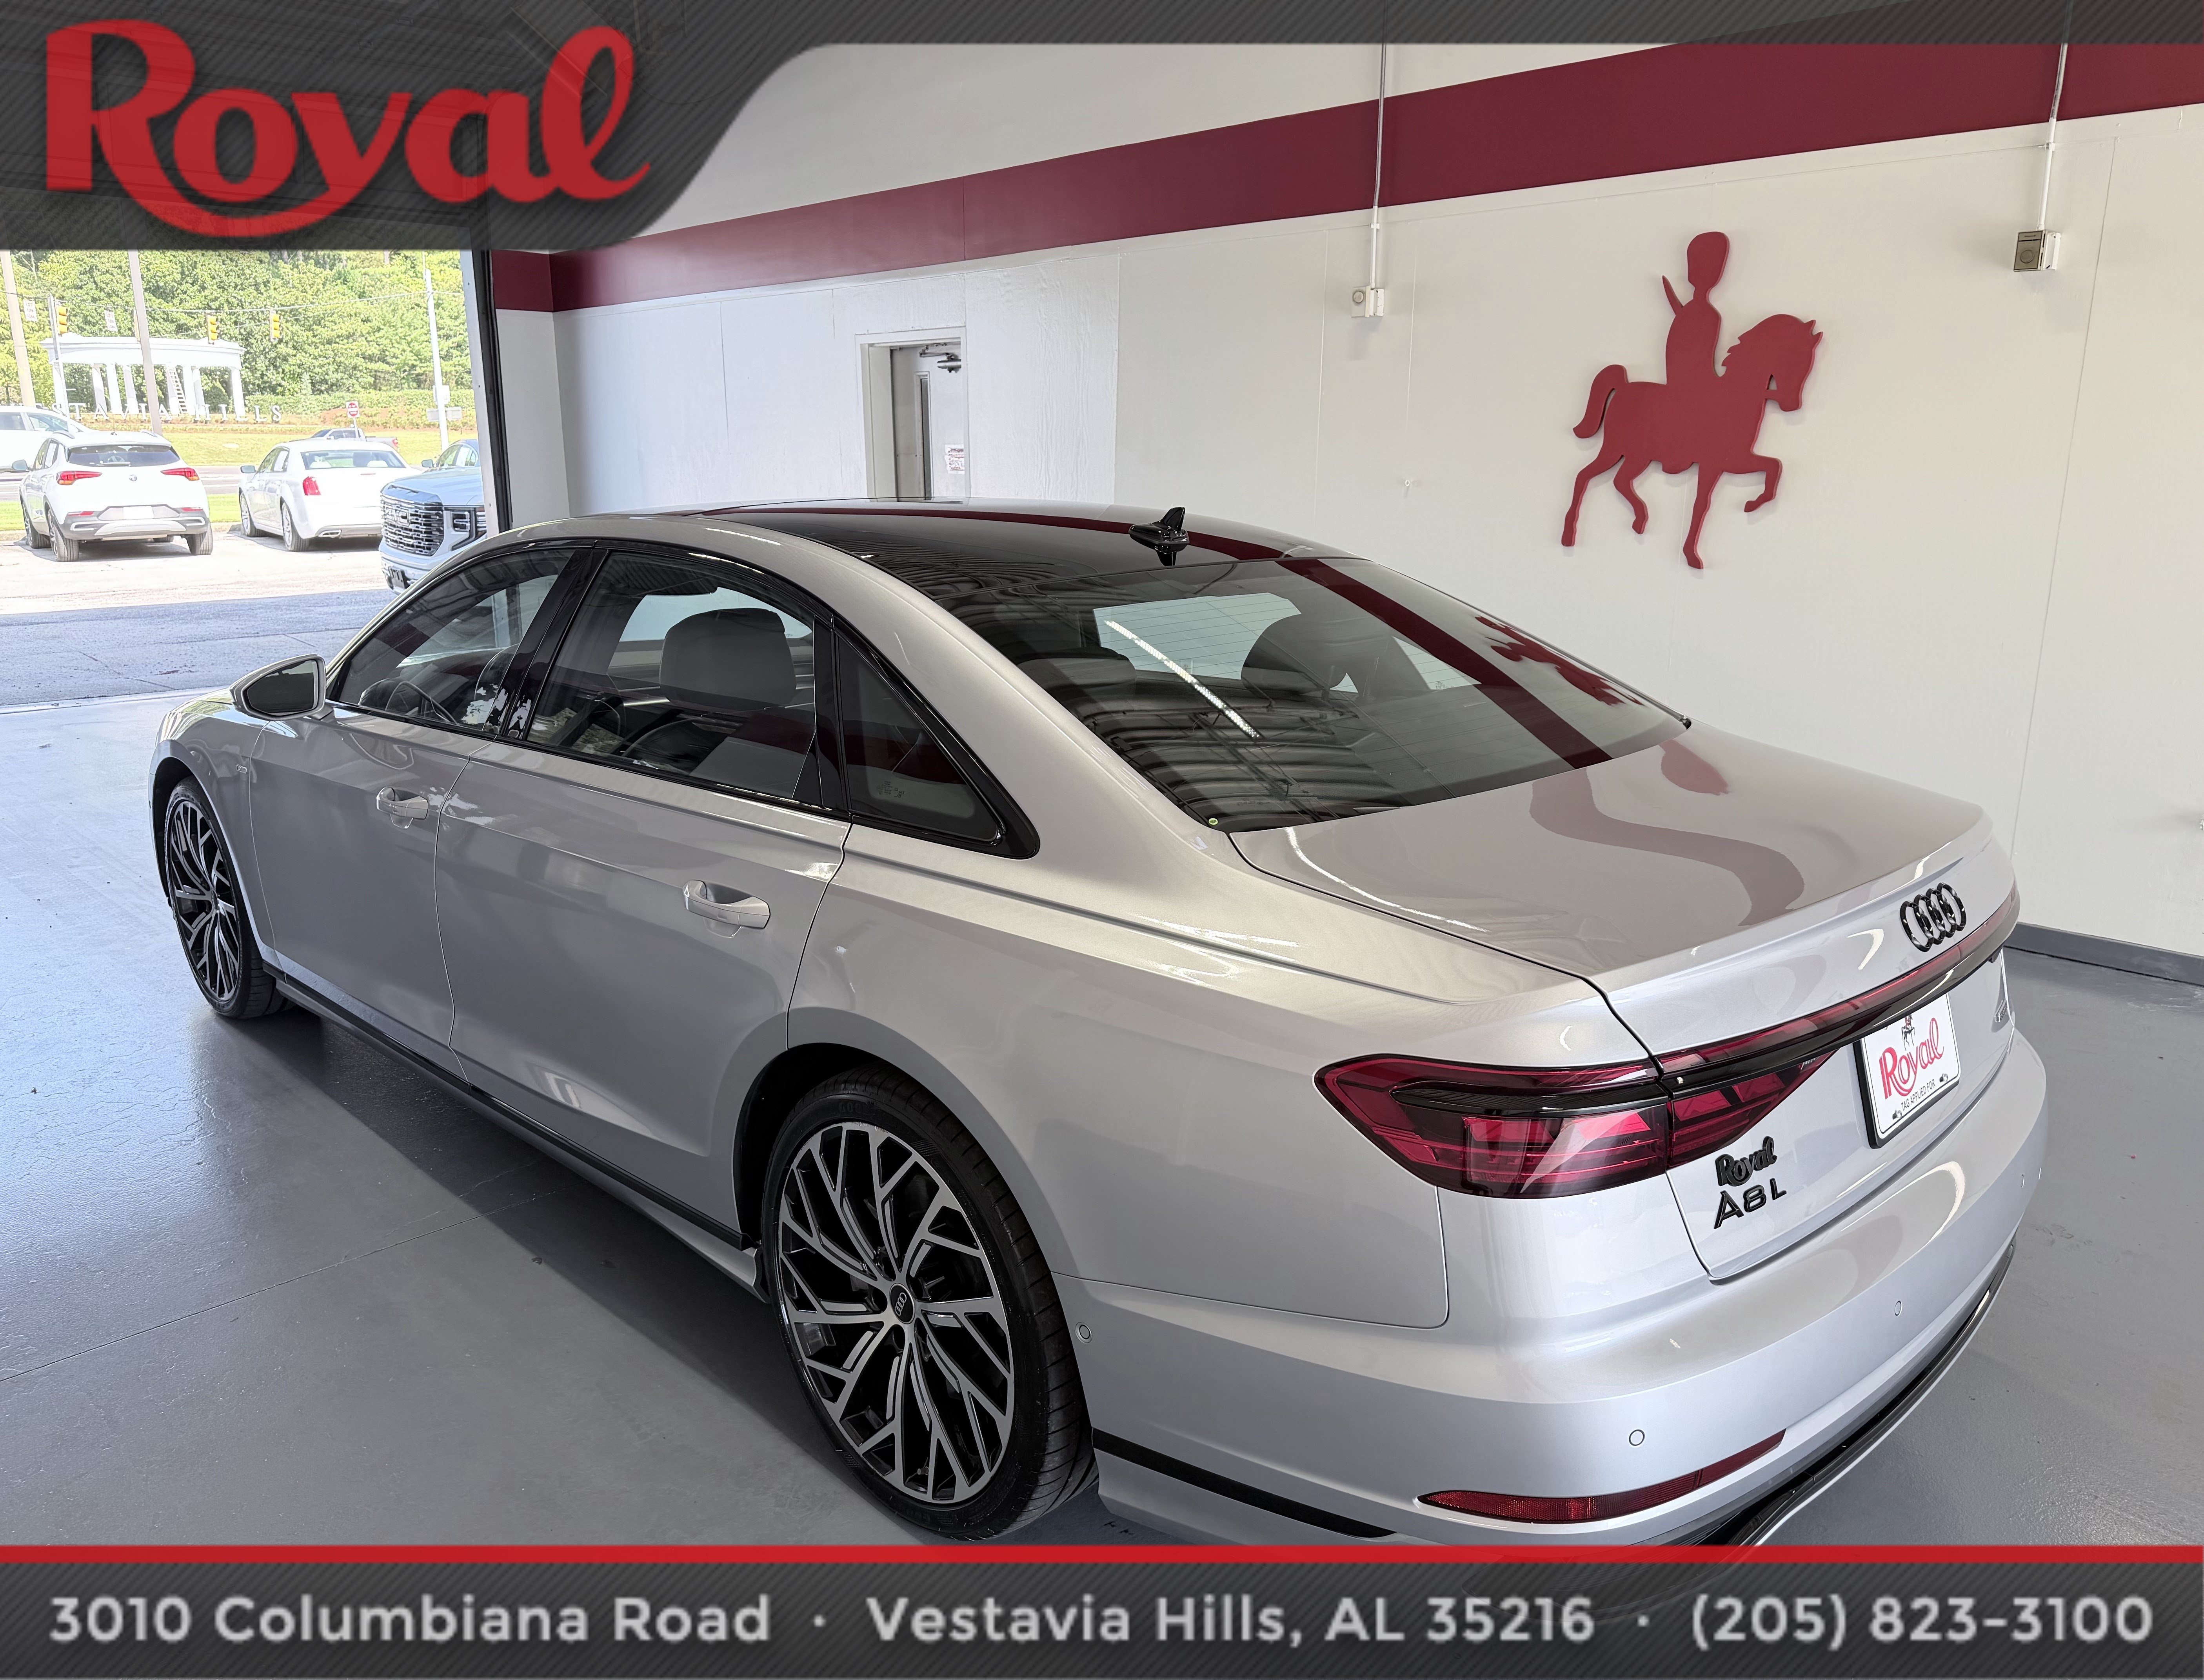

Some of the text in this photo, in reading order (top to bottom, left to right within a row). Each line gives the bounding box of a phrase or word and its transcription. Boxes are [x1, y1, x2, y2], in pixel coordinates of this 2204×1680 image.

[1879, 1018, 1945, 1100] Royal
[1901, 1079, 1935, 1111] TAG APPLIED FOR
[1715, 1136, 1777, 1187] Royal
